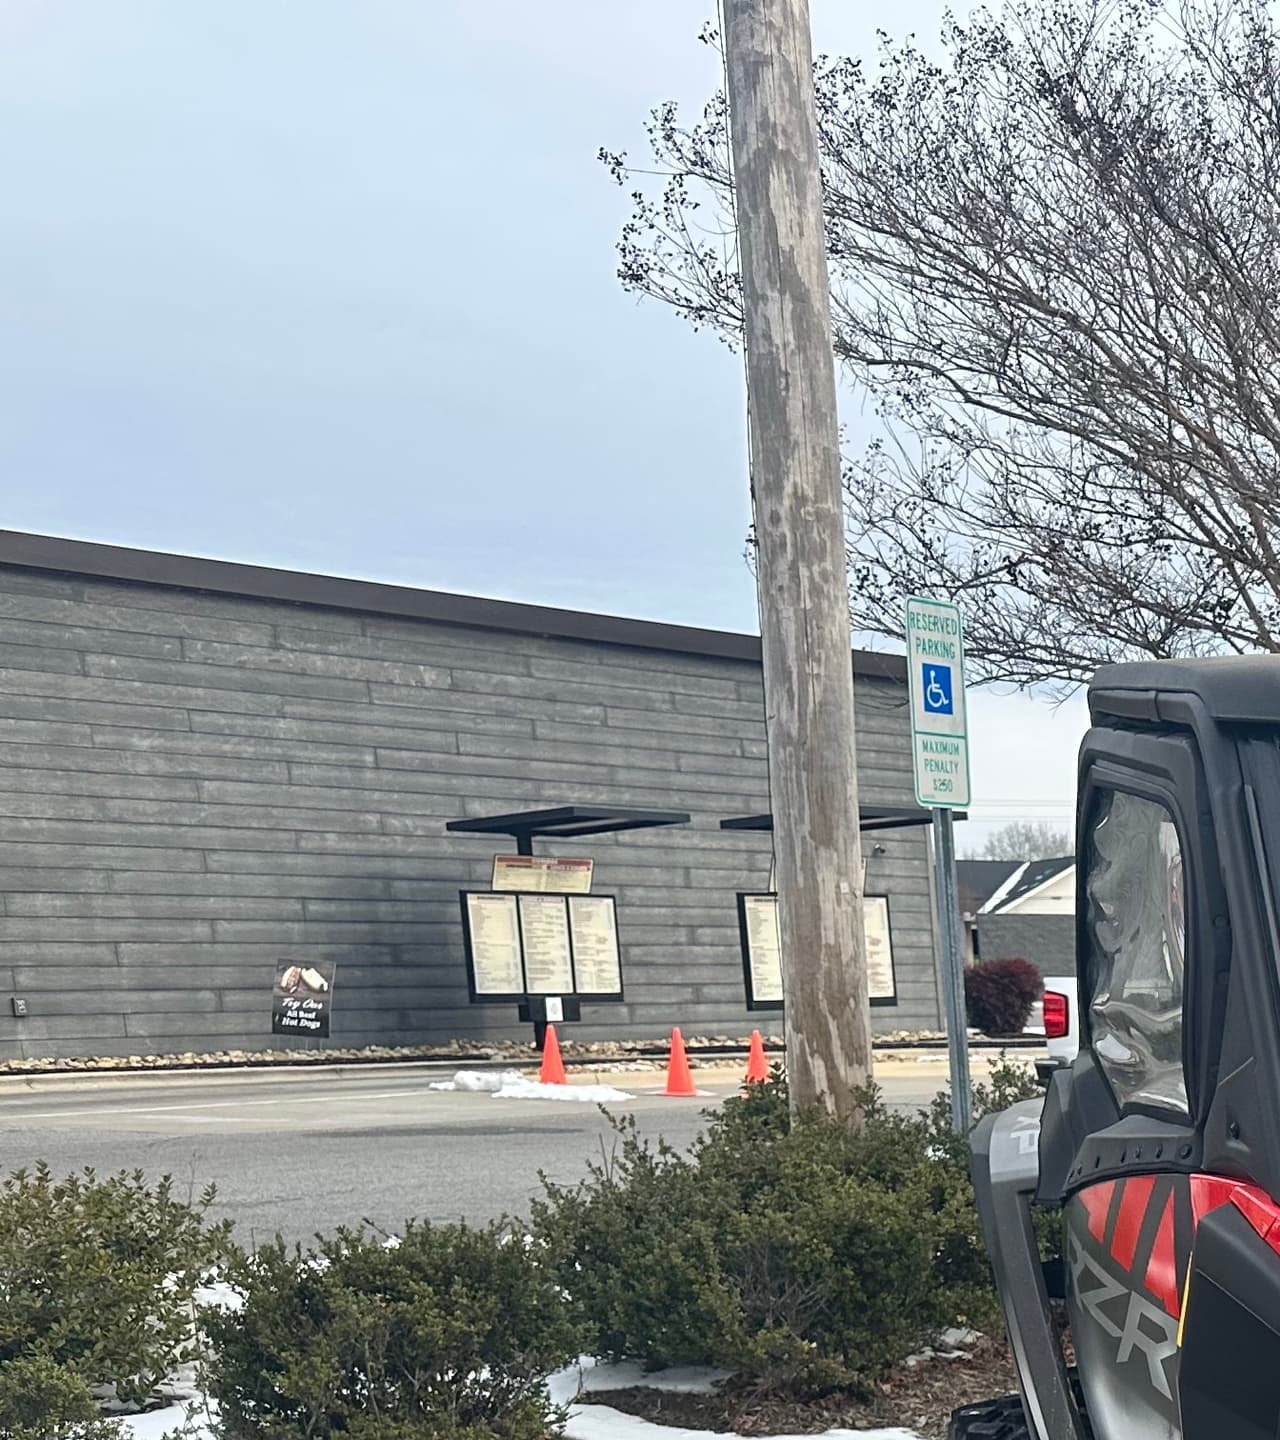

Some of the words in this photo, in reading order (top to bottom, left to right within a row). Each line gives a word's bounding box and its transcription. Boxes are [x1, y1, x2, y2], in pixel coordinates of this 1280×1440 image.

[909, 611, 958, 636] RESERVED
[915, 636, 956, 660] PARKING
[922, 738, 960, 756] MAXIMUM
[923, 758, 959, 775] PENALTY
[933, 778, 953, 793] $250
[281, 997, 301, 1010] Try
[286, 1010, 298, 1018] All
[281, 1017, 299, 1027] Hot
[299, 1018, 321, 1030] Dogs
[1067, 1224, 1180, 1402] RZR
